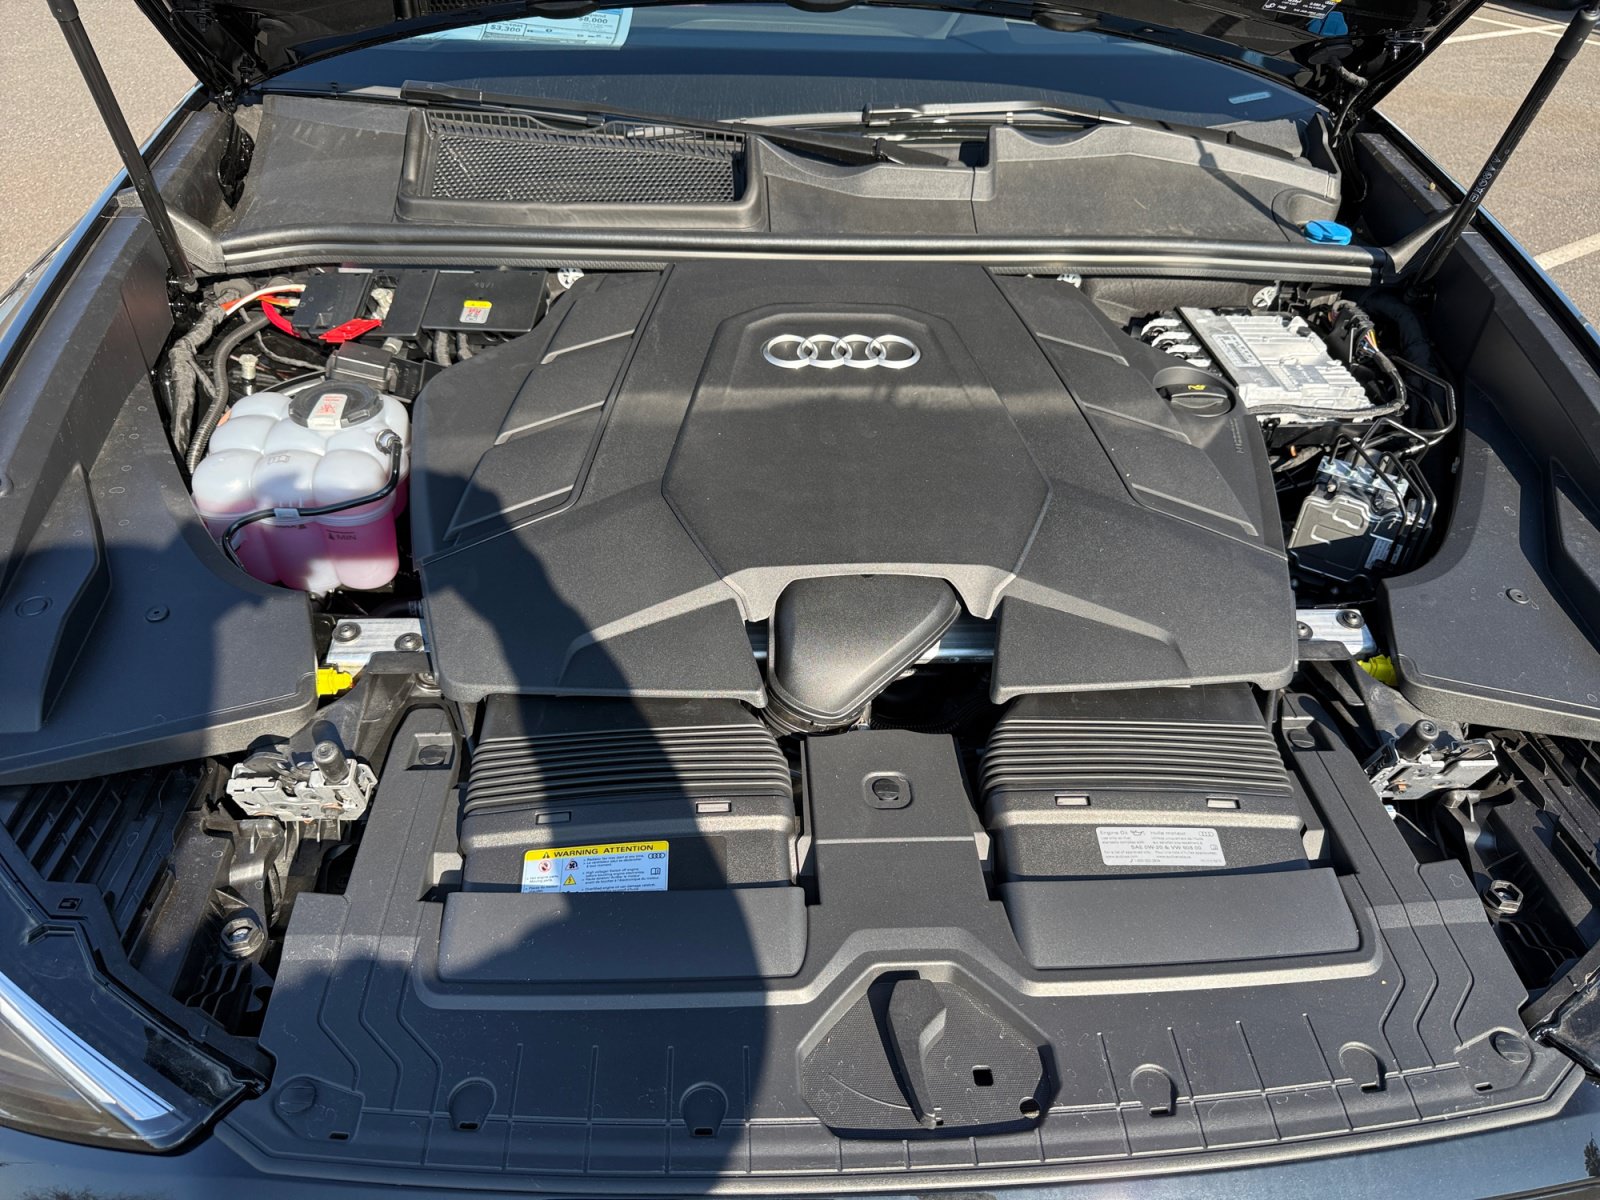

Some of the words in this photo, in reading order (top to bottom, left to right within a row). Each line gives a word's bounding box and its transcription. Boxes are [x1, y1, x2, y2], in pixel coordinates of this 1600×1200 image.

[490, 24, 521, 33] $3,300
[553, 848, 599, 858] WARNING
[603, 844, 654, 855] ATTENTION
